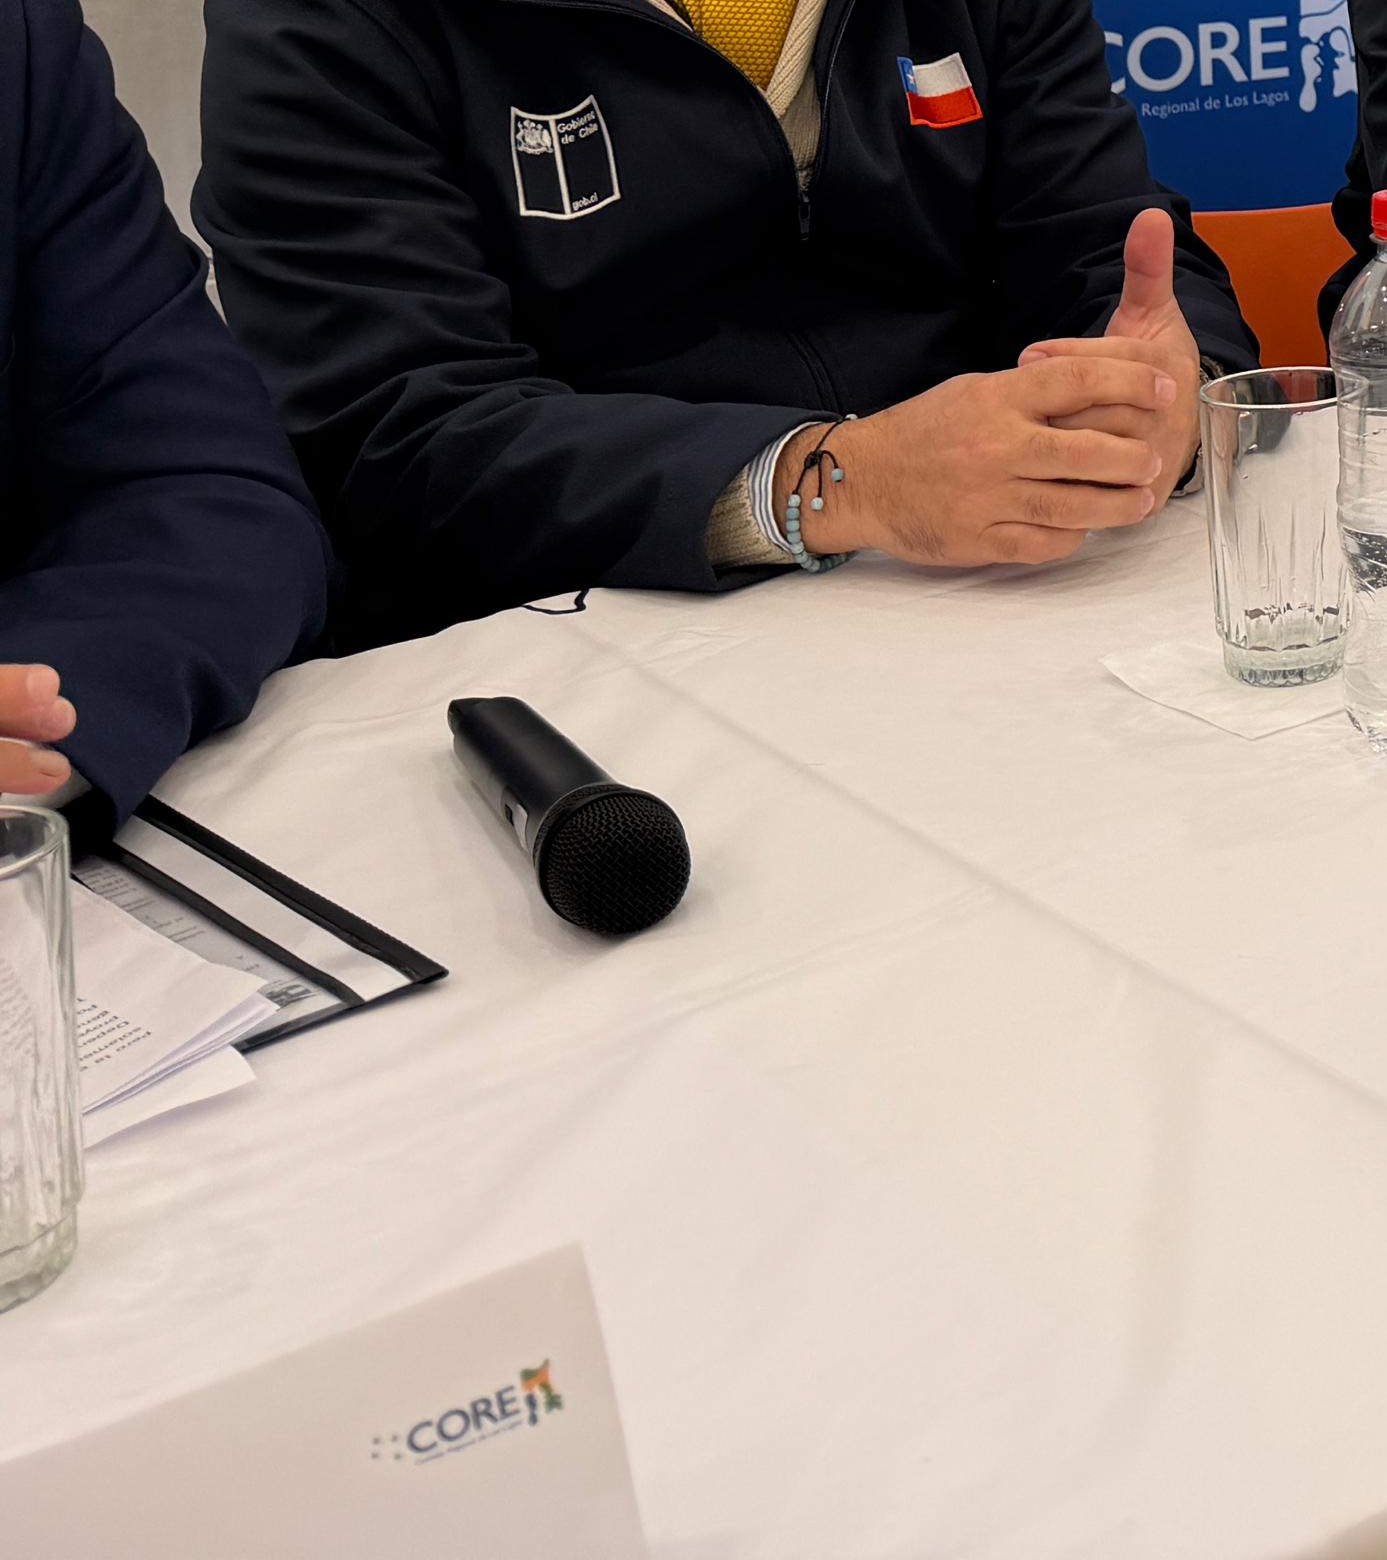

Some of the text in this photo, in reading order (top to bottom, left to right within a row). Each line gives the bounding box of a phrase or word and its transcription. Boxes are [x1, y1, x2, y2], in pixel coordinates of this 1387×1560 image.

[1141, 90, 1289, 118] Regional de Los Lagos
[561, 134, 575, 144] de
[407, 1385, 521, 1454] CORE
